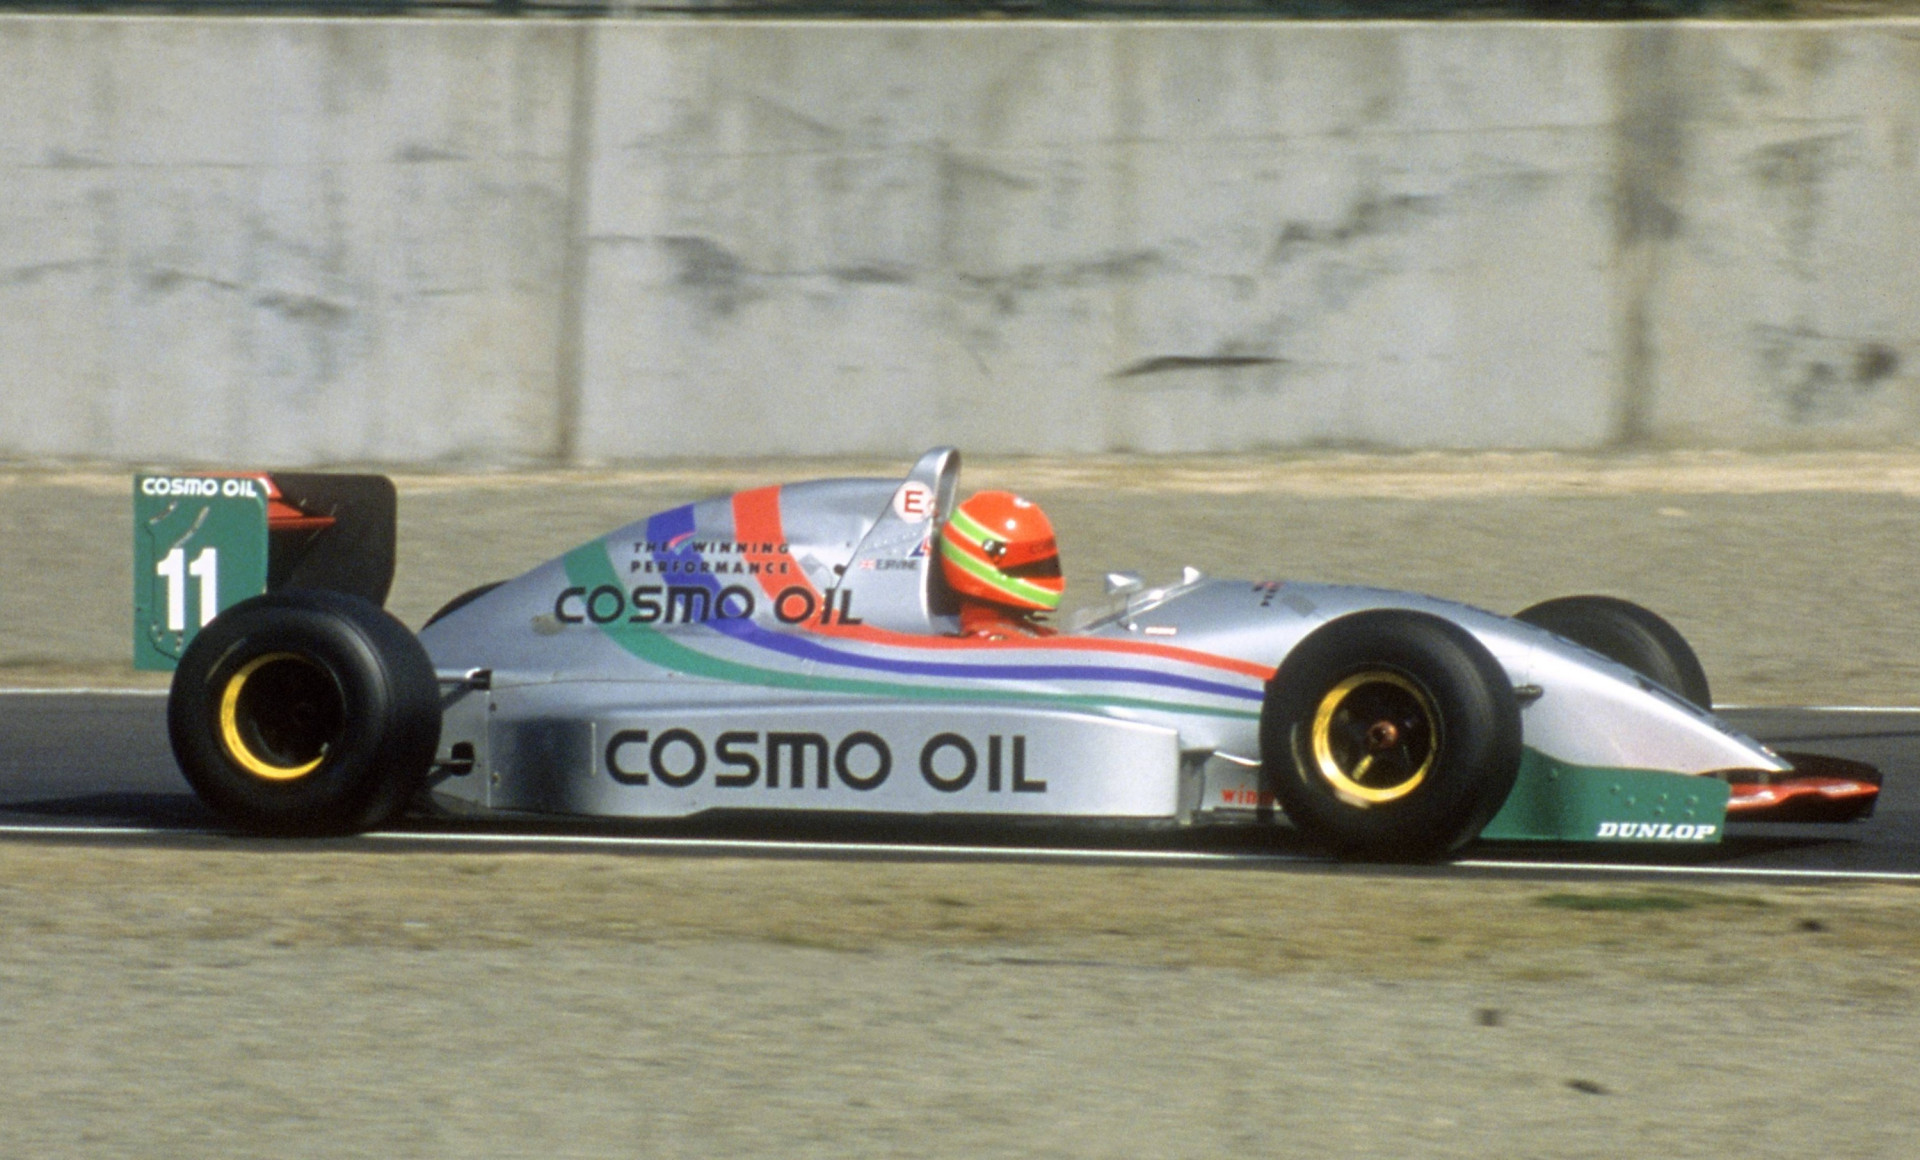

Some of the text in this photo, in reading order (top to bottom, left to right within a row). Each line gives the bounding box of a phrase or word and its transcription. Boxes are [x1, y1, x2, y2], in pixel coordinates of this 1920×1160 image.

[142, 478, 257, 497] COSMO OIL
[904, 490, 923, 514] E
[633, 541, 789, 554] THE WINNING
[630, 560, 788, 574] PERFORMANCE
[157, 548, 217, 631] 11
[555, 584, 862, 625] COSMO OIL
[605, 727, 1047, 793] COSMO OIL
[1597, 822, 1717, 839] DUNLOP
